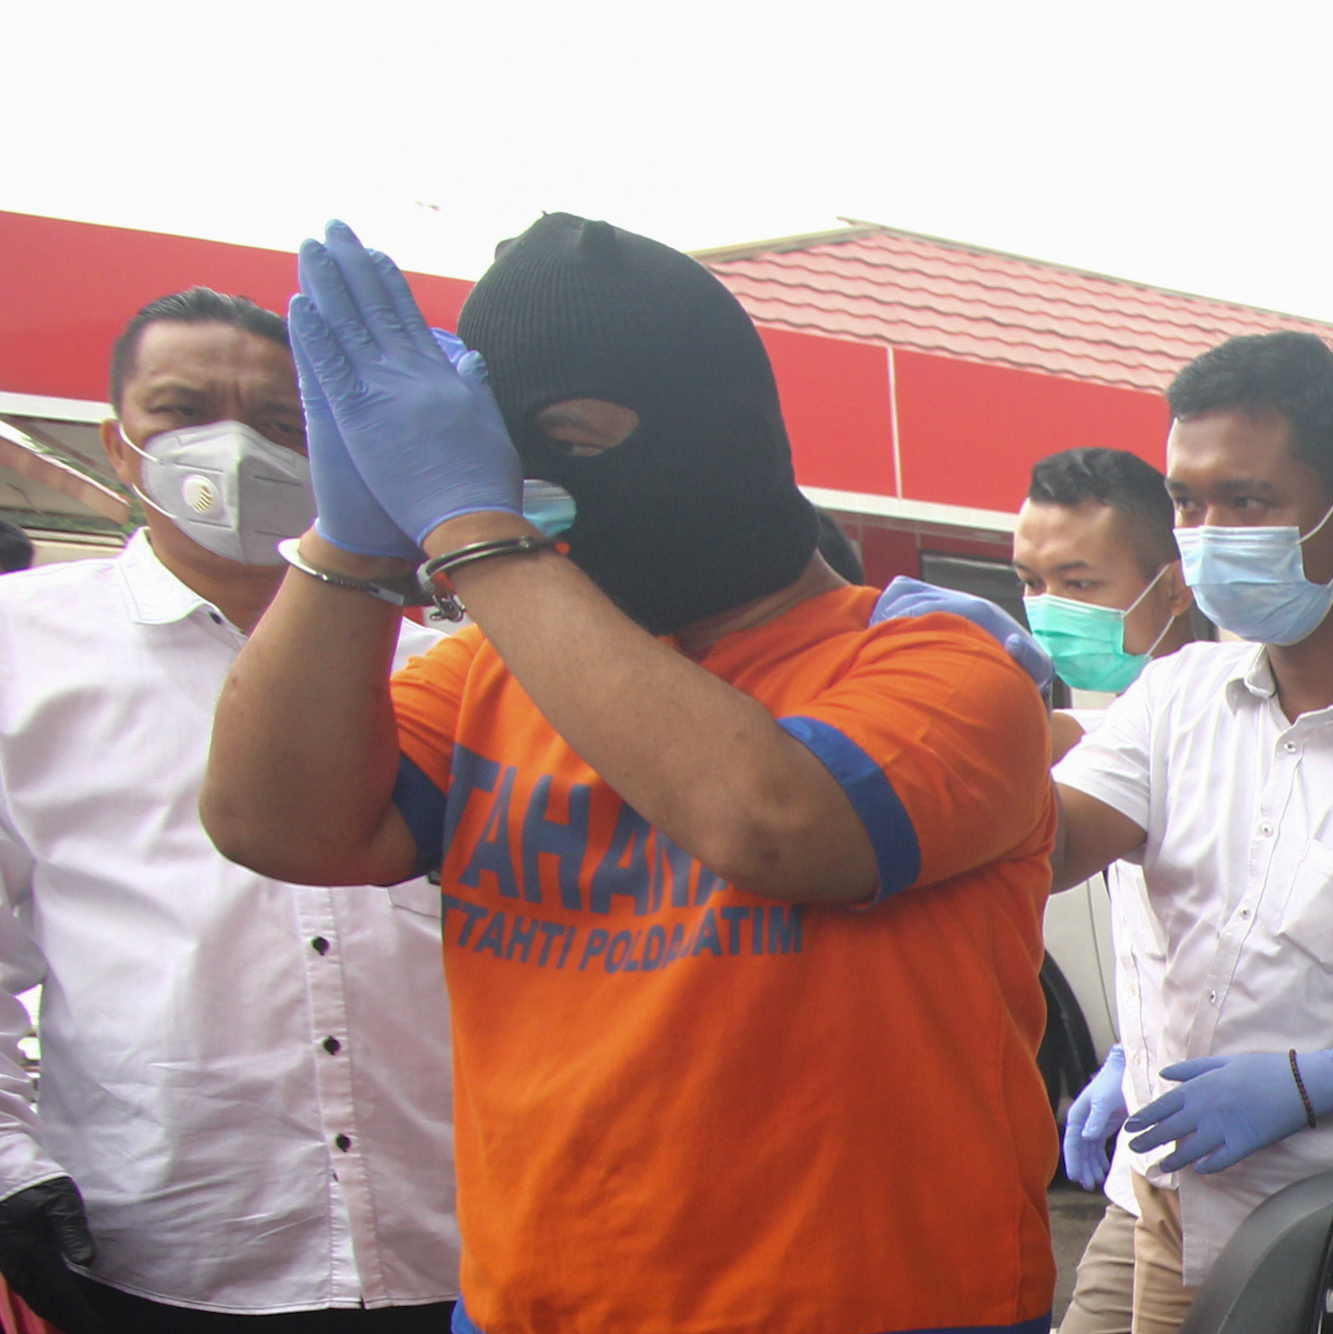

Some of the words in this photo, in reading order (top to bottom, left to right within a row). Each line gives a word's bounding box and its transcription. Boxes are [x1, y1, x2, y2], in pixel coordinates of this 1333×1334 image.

[441, 743, 727, 916] TAHAN
[457, 902, 577, 969] TAHTI
[578, 922, 686, 975] POLDA
[681, 905, 803, 957] ATIM
